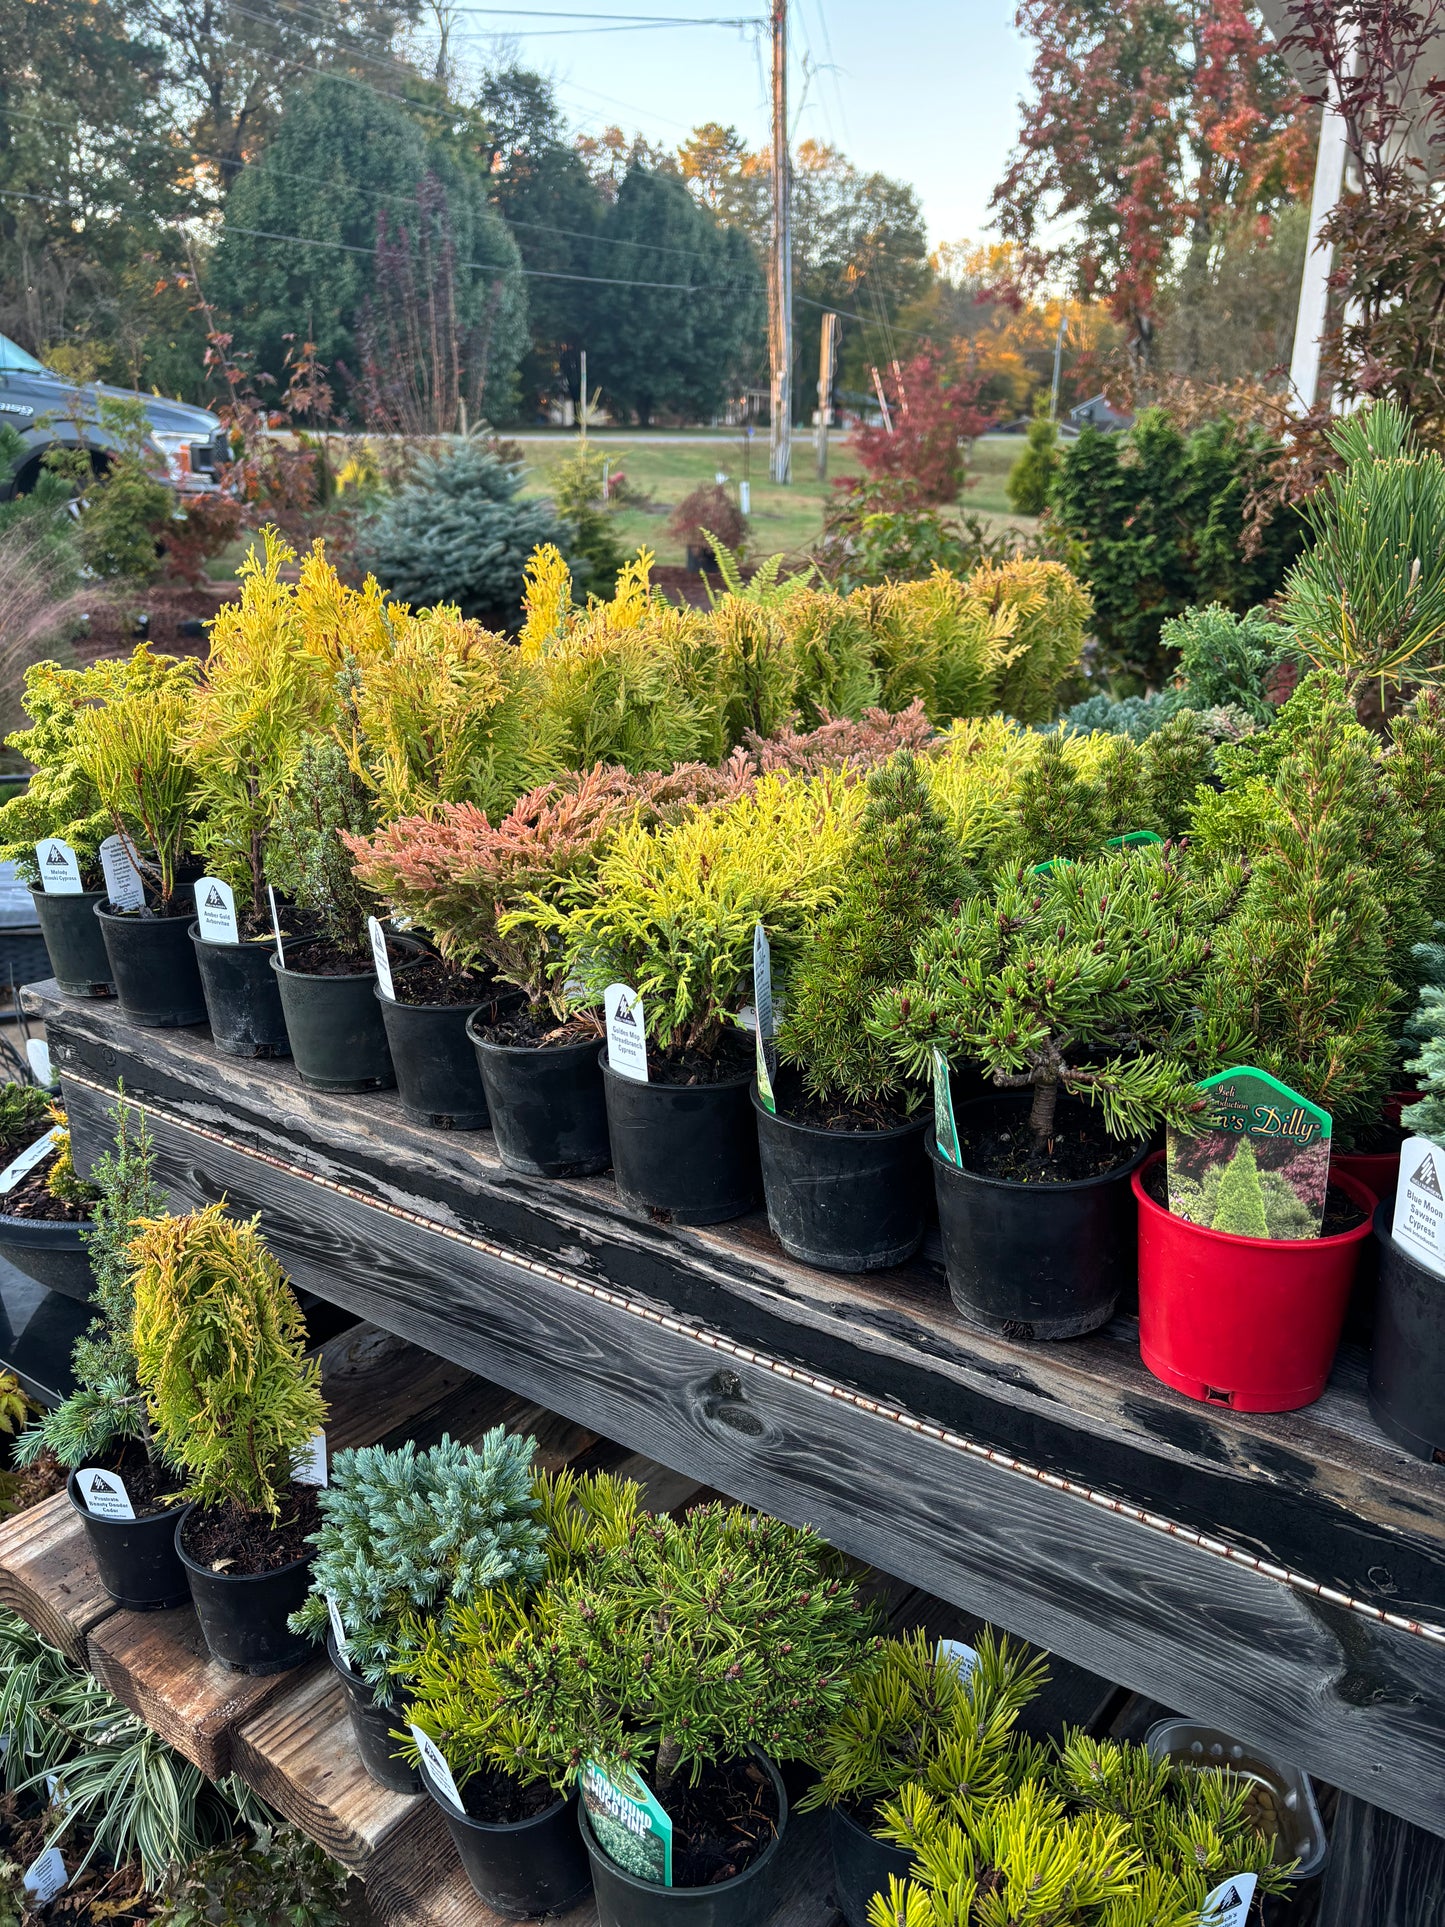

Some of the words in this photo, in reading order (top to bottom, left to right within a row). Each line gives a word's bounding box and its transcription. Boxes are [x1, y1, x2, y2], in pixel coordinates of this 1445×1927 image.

[611, 1033, 643, 1050] Threadbranch
[612, 1025, 629, 1037] Golden
[629, 1031, 640, 1042] Mop
[618, 1044, 636, 1056] Cypress
[1216, 1084, 1235, 1097] Iseli
[1251, 1107, 1314, 1143] Dilly
[1406, 1189, 1423, 1206] Blue
[1423, 1200, 1444, 1219] Moon
[1410, 1204, 1437, 1227] Sawara
[1408, 1214, 1436, 1239] Cypress
[591, 1778, 619, 1816] MUGO
[620, 1807, 647, 1839] PINE
